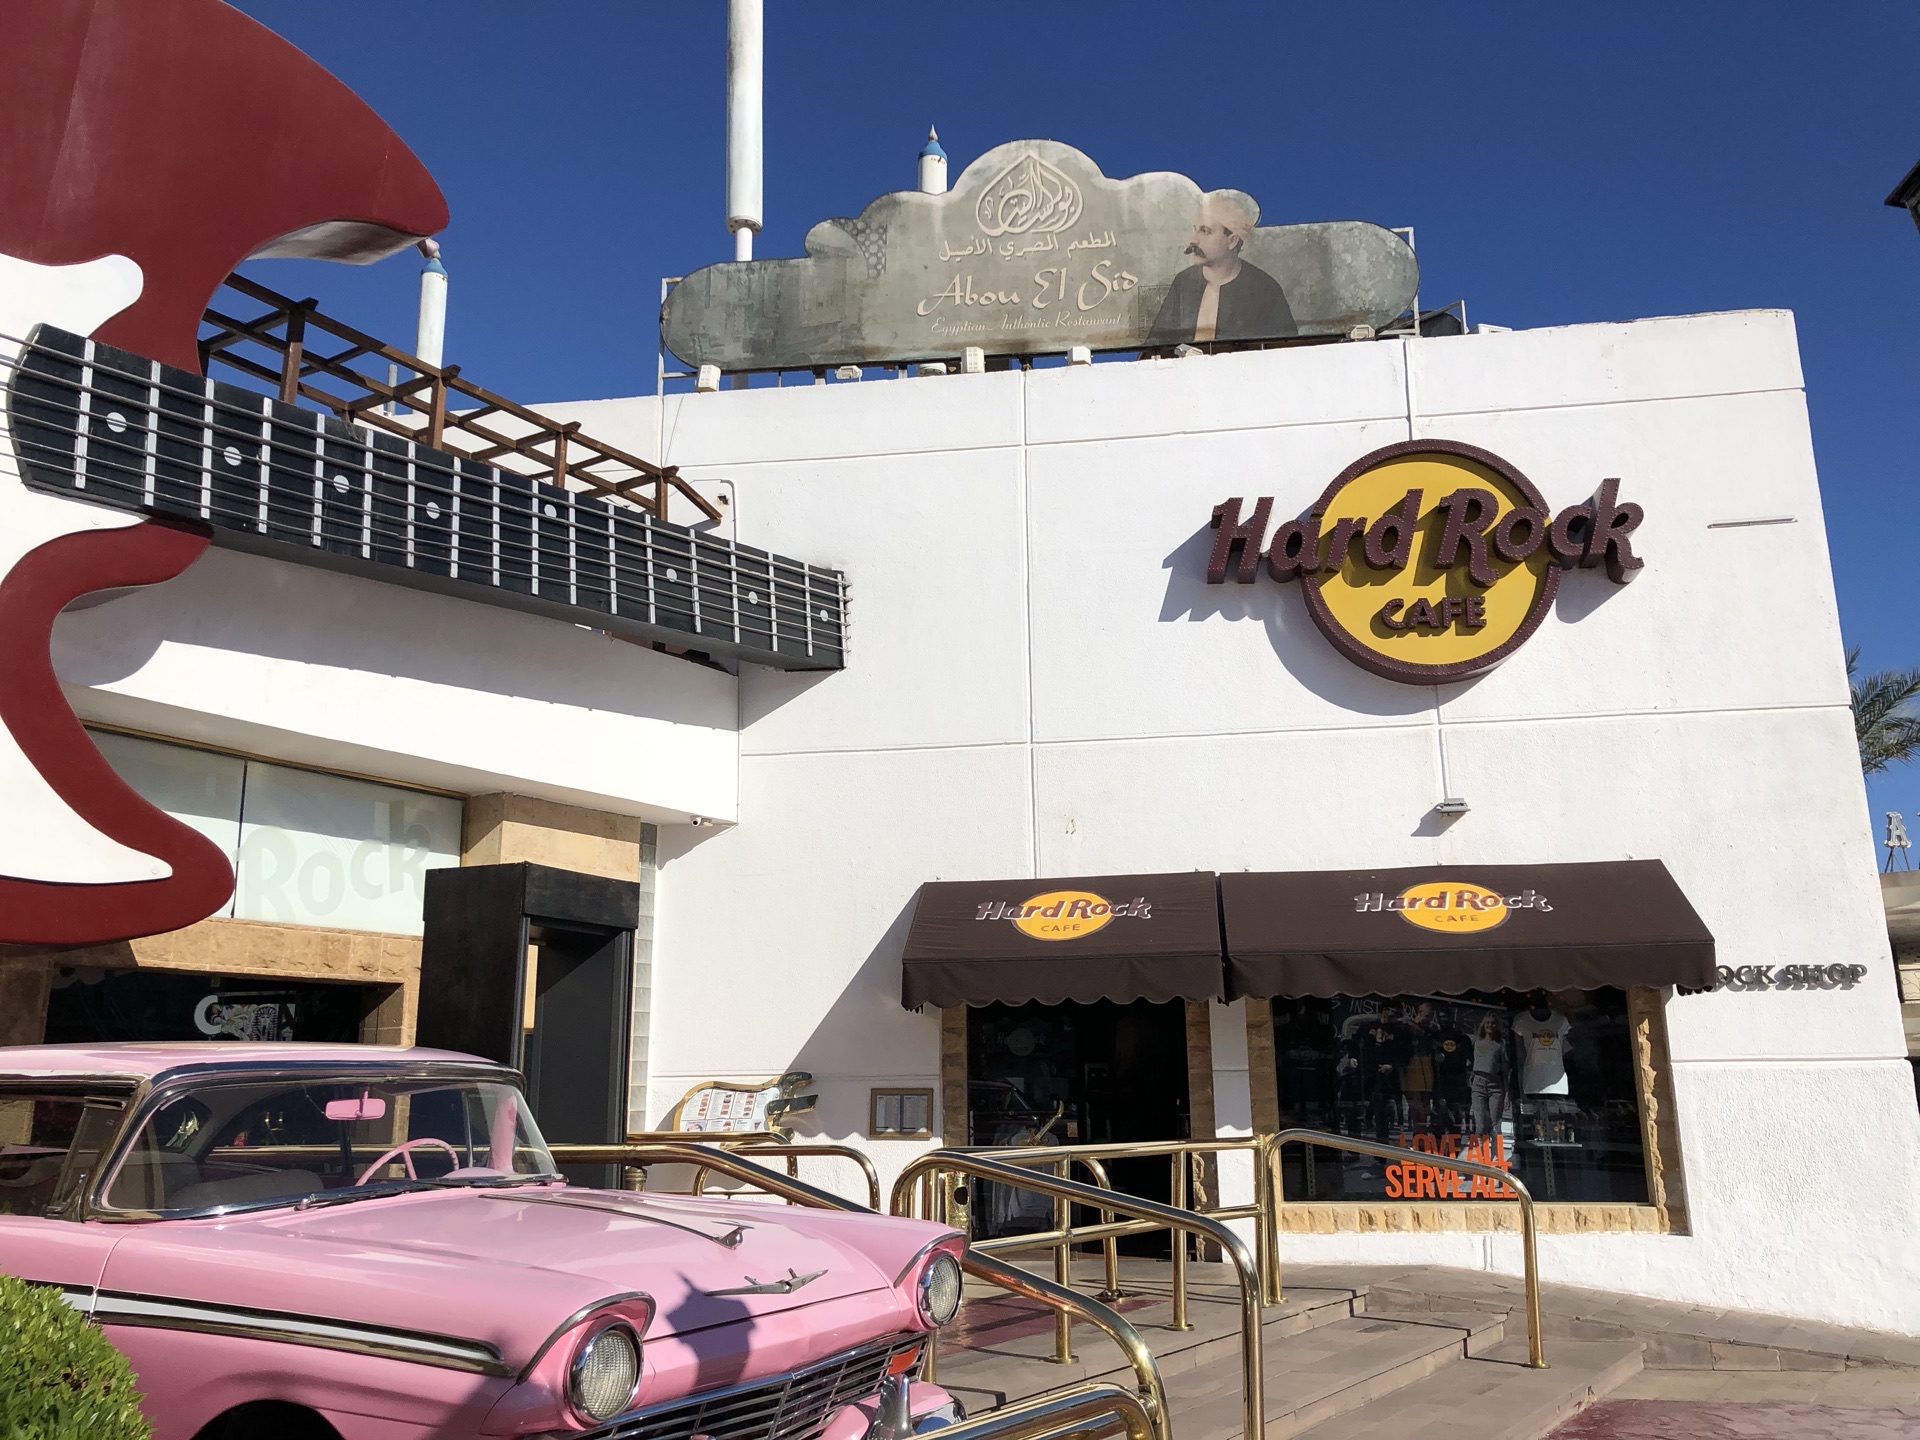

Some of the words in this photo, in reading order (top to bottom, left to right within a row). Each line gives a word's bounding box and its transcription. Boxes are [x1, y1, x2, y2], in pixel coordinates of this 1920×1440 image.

[999, 232, 1059, 261] المصري
[1067, 231, 1118, 259] المطعم
[916, 273, 1021, 316] Abou
[1032, 267, 1067, 309] El
[1077, 260, 1139, 312] Sid
[931, 316, 986, 337] Egyptian
[986, 313, 1051, 333] Authentic
[1054, 310, 1122, 328] Restaurant
[1206, 487, 1425, 584] Hard
[1436, 477, 1646, 588] Rock
[1380, 595, 1488, 631] CAFE
[232, 800, 431, 923] Rock
[975, 900, 1066, 921] Hard
[1065, 897, 1153, 921] Rock
[1353, 890, 1450, 912] Hard
[1453, 889, 1554, 912] Rock
[1041, 923, 1081, 933] CAFE
[1434, 914, 1480, 923] CAFE
[1715, 964, 1778, 985] OCK
[1783, 962, 1868, 985] SHOP
[1466, 1133, 1513, 1168] ALL
[1385, 1164, 1467, 1199] SERVE
[1470, 1164, 1519, 1199] ALL
